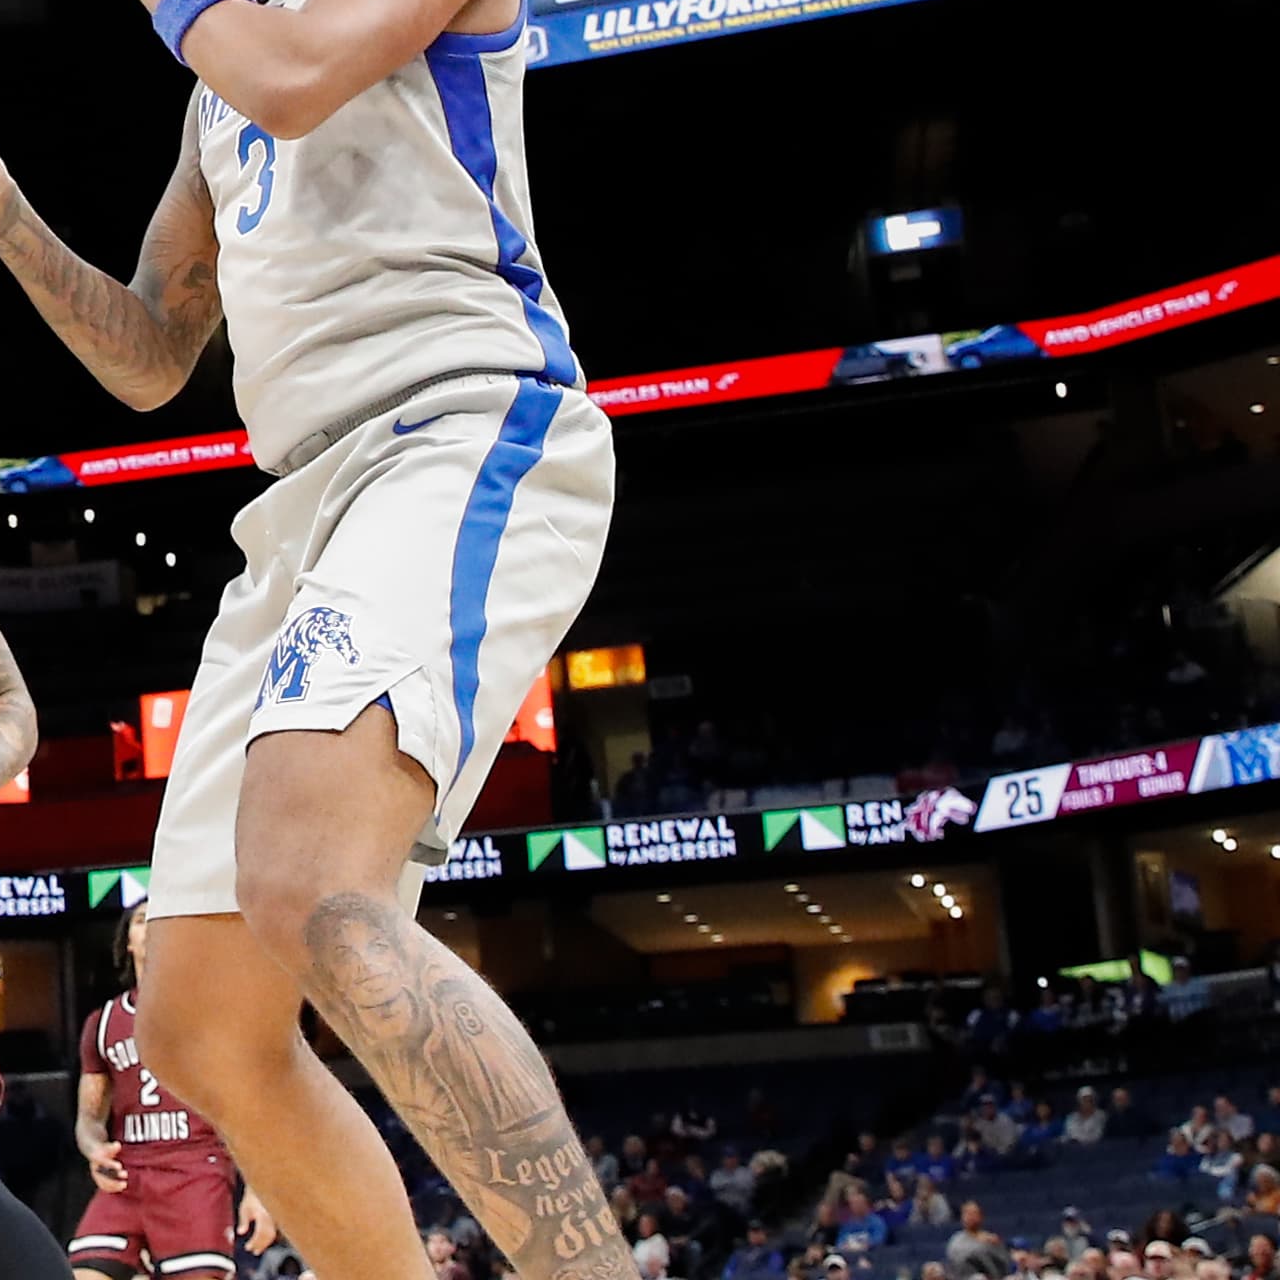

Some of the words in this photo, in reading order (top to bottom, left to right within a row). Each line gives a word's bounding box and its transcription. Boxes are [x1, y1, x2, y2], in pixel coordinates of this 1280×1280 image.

[688, 20, 721, 34] FOR
[237, 122, 277, 237] 3
[119, 448, 190, 470] VEHICLES
[1005, 777, 1041, 819] 25
[606, 815, 735, 848] RENEWAL
[626, 838, 737, 866] ANDERSEN
[139, 1067, 161, 1108] 2
[123, 1110, 191, 1144] ILLINOIS
